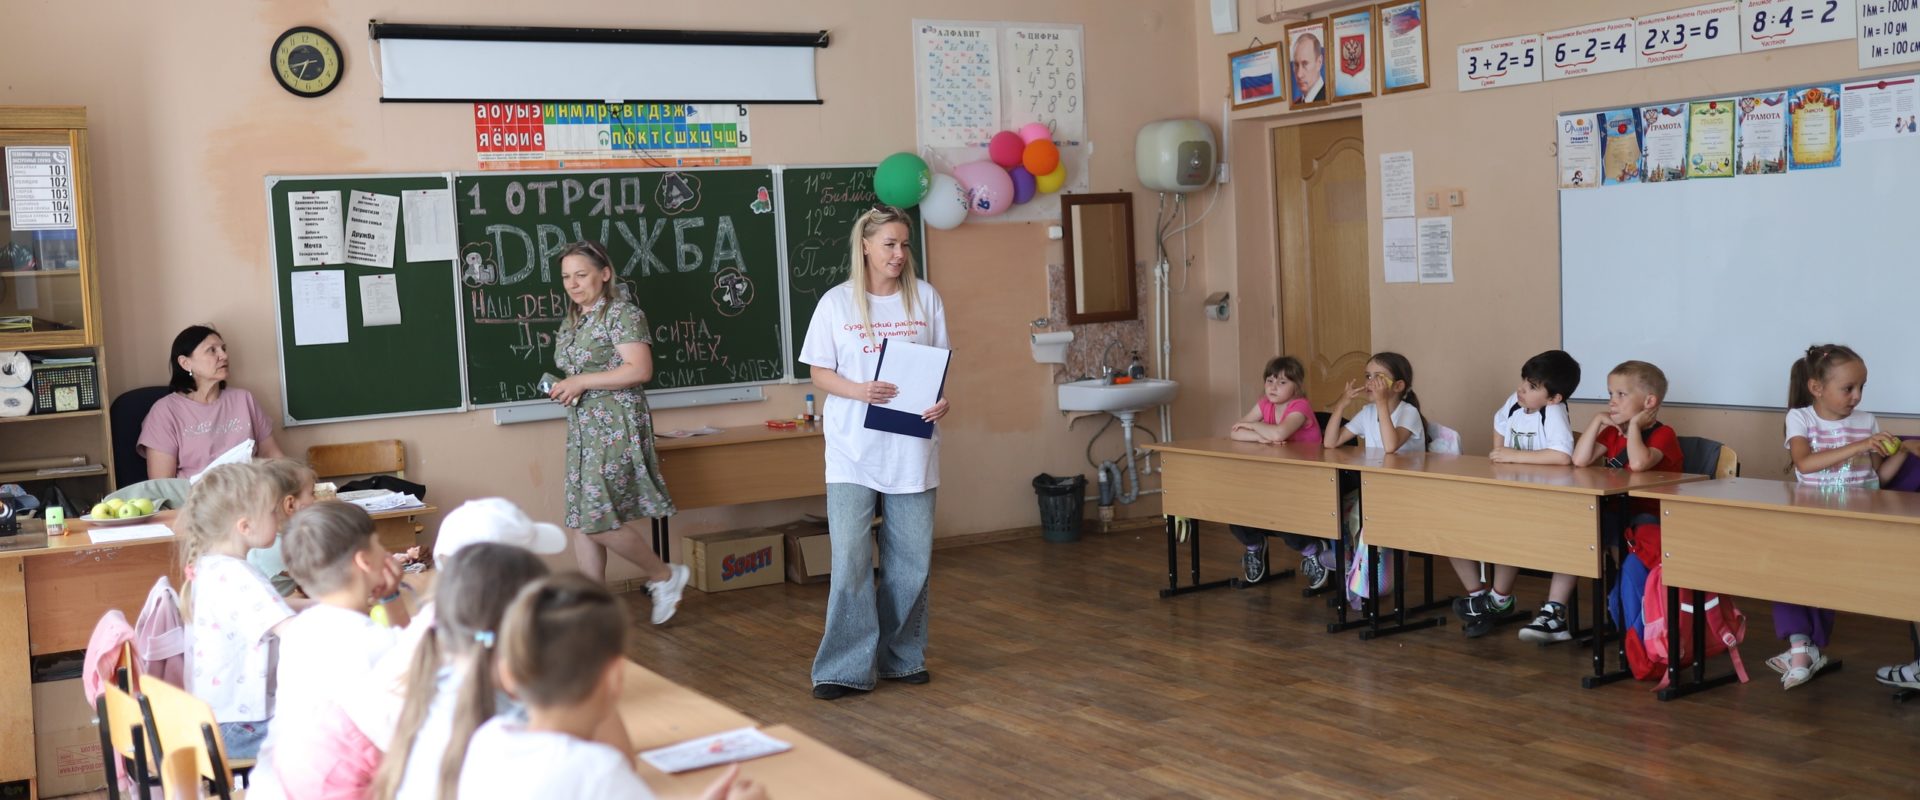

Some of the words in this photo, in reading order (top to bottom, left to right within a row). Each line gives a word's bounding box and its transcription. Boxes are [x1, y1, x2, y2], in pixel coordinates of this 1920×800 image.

[1753, 11, 1767, 33] 8
[1779, 6, 1794, 28] 4
[1820, 0, 1838, 24] 2
[937, 29, 981, 38] АЛФАВИТ
[1027, 32, 1059, 40] ЦИФРЫ
[1645, 28, 1658, 50] 2
[1673, 23, 1685, 45] 3
[1705, 18, 1719, 40] 6
[1555, 43, 1567, 63] 6
[1585, 38, 1598, 59] 2
[1614, 33, 1627, 54] 4
[1046, 48, 1055, 66] 2
[1065, 48, 1074, 67] 3
[1467, 56, 1478, 75] 3
[1496, 51, 1508, 71] 2
[1523, 48, 1534, 68] 5
[1047, 71, 1057, 89] 5
[1066, 72, 1076, 90] 6
[1048, 95, 1057, 113] 8
[1067, 95, 1077, 114] 9
[1746, 112, 1781, 121] ГРАМОТА
[1650, 122, 1682, 132] ГРАМОТА
[49, 165, 66, 175] 101
[50, 177, 67, 187] 102
[51, 189, 68, 199] 103
[467, 181, 487, 215] 1
[505, 177, 646, 216] ОТРЯД
[52, 201, 69, 211] 104
[53, 213, 70, 223] 112
[351, 230, 375, 240] Дружба
